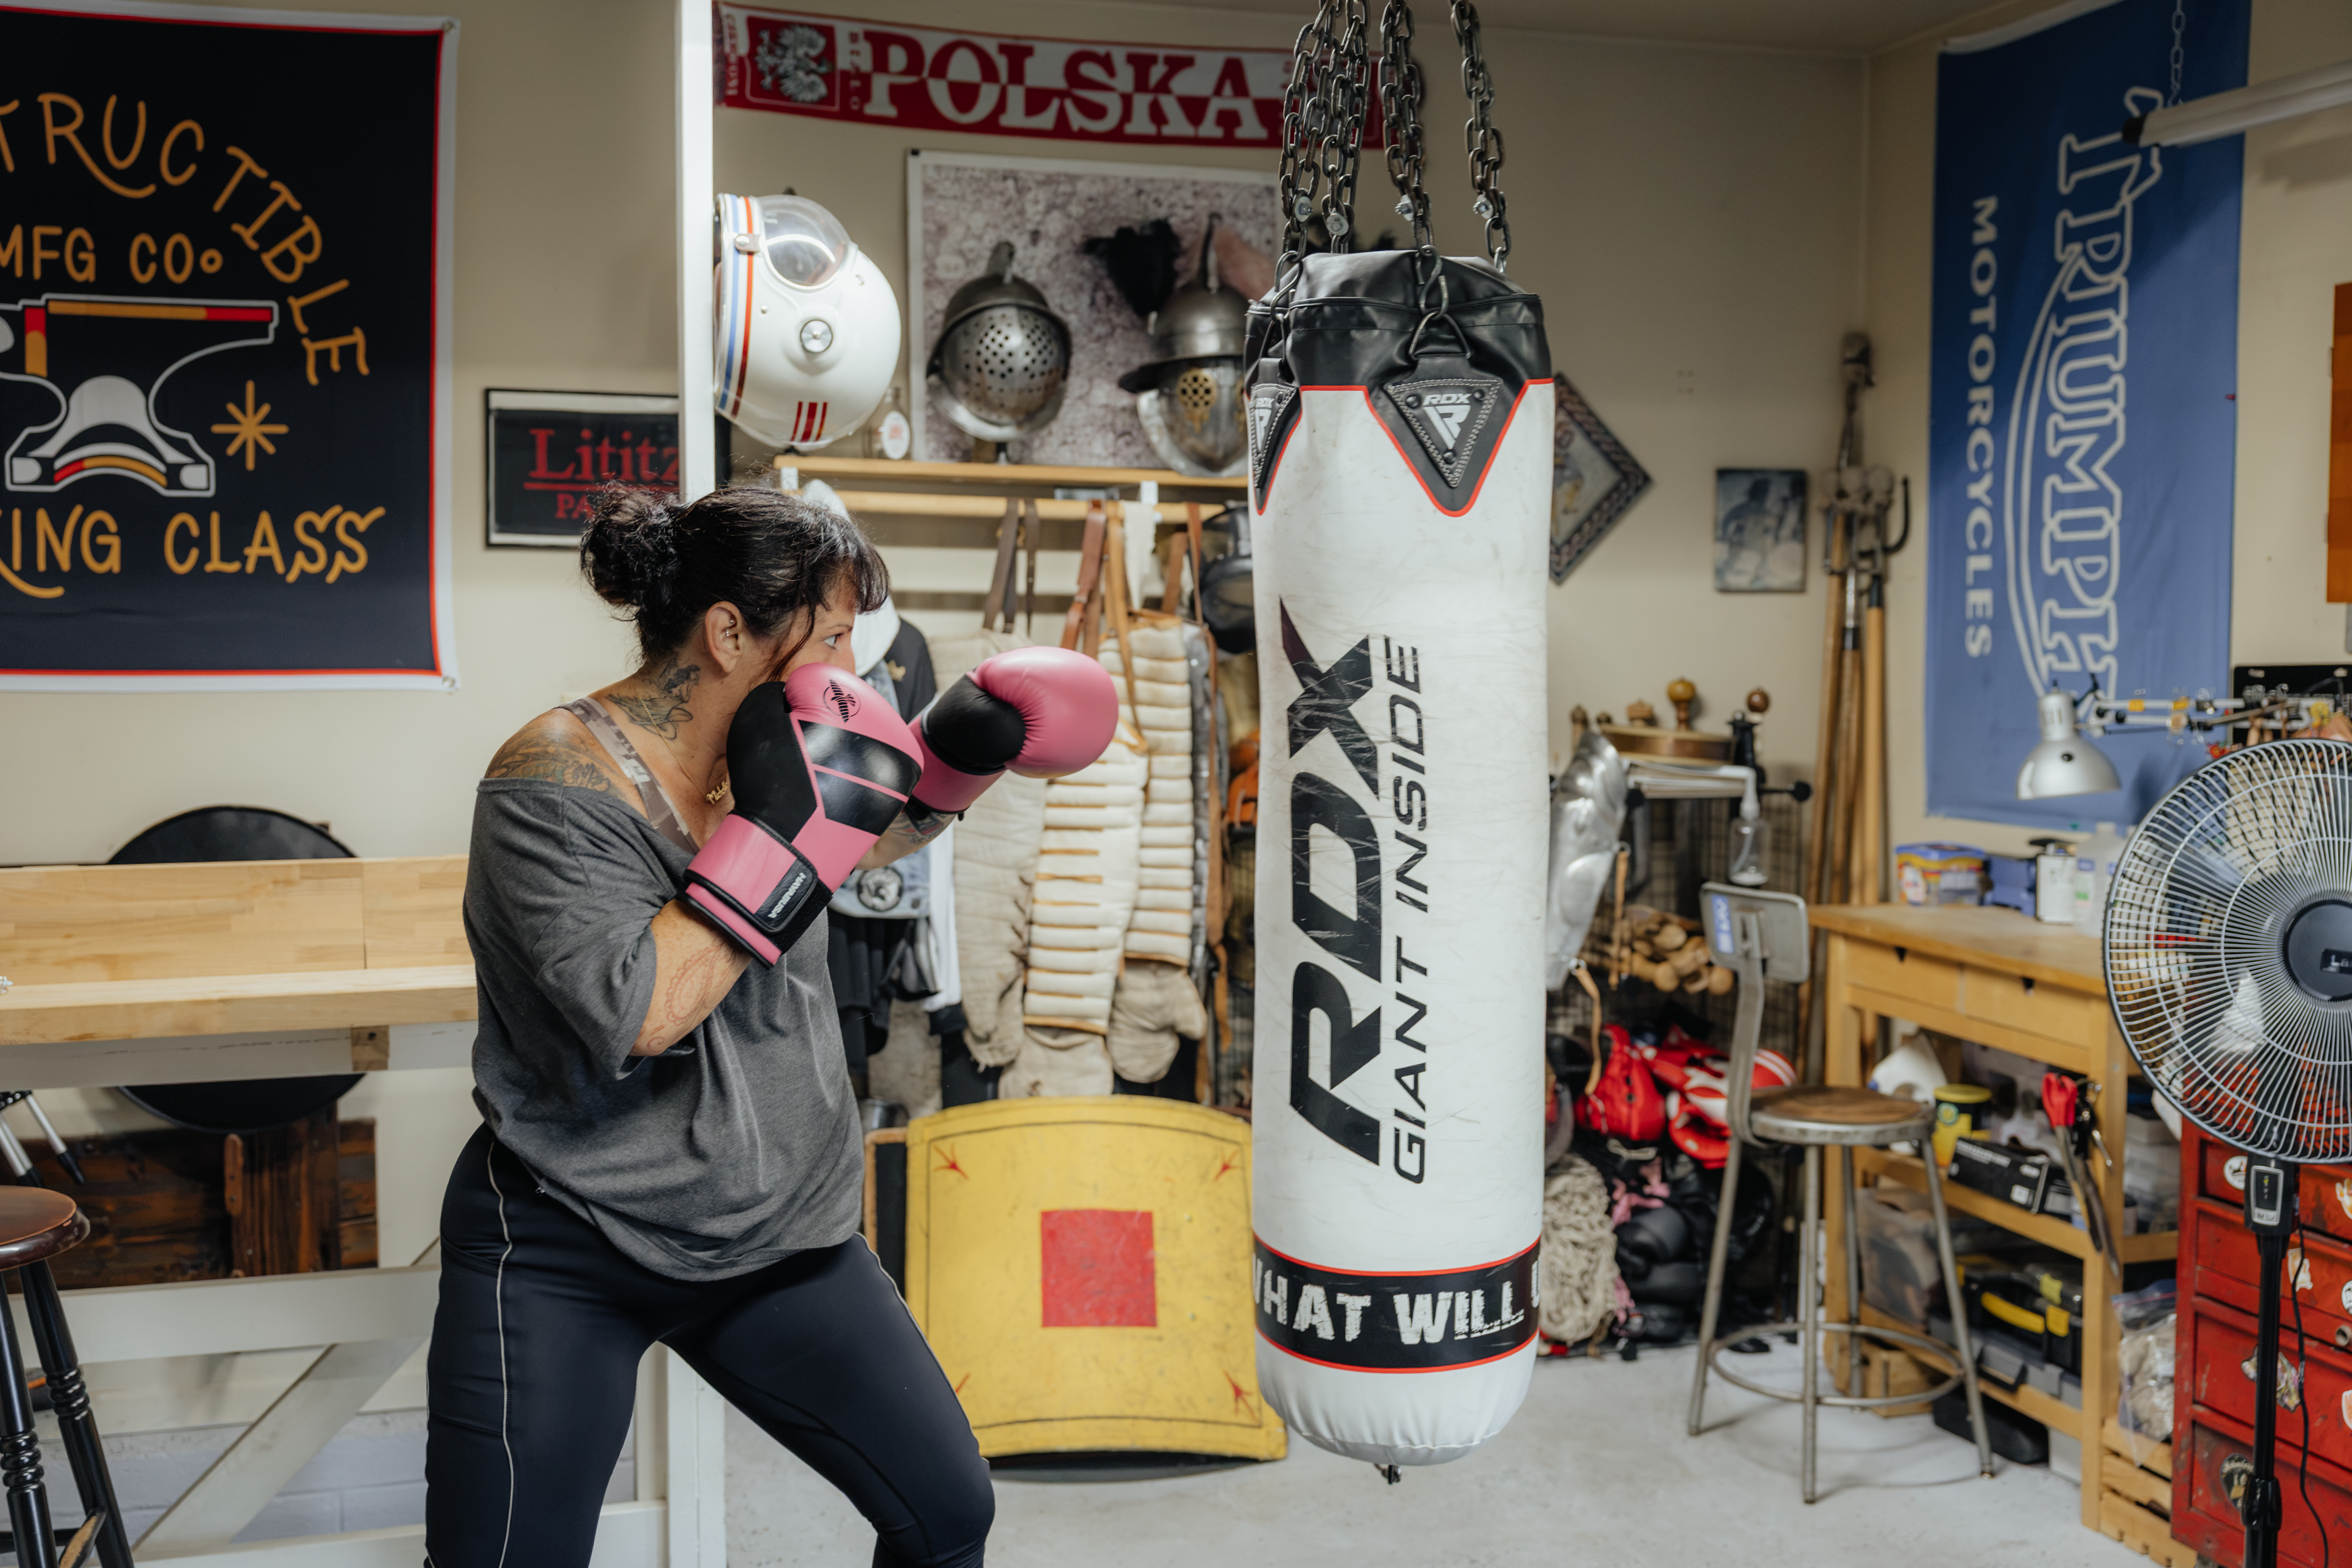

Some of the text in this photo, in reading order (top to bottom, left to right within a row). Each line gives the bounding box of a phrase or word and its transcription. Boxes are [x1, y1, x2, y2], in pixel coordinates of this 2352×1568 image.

[863, 30, 1268, 140] POLSKA
[0, 224, 96, 283] MFG
[1422, 393, 1472, 406] RDX
[1965, 195, 1998, 657] MOTORCYCLES
[528, 428, 679, 482] Lititz
[0, 503, 386, 584] ING CLASS
[767, 872, 807, 918] HAYABUSA
[1279, 594, 1382, 1166] RDX
[1383, 634, 1428, 1184] GIANT INSIDE
[1393, 1281, 1525, 1345] WILL
